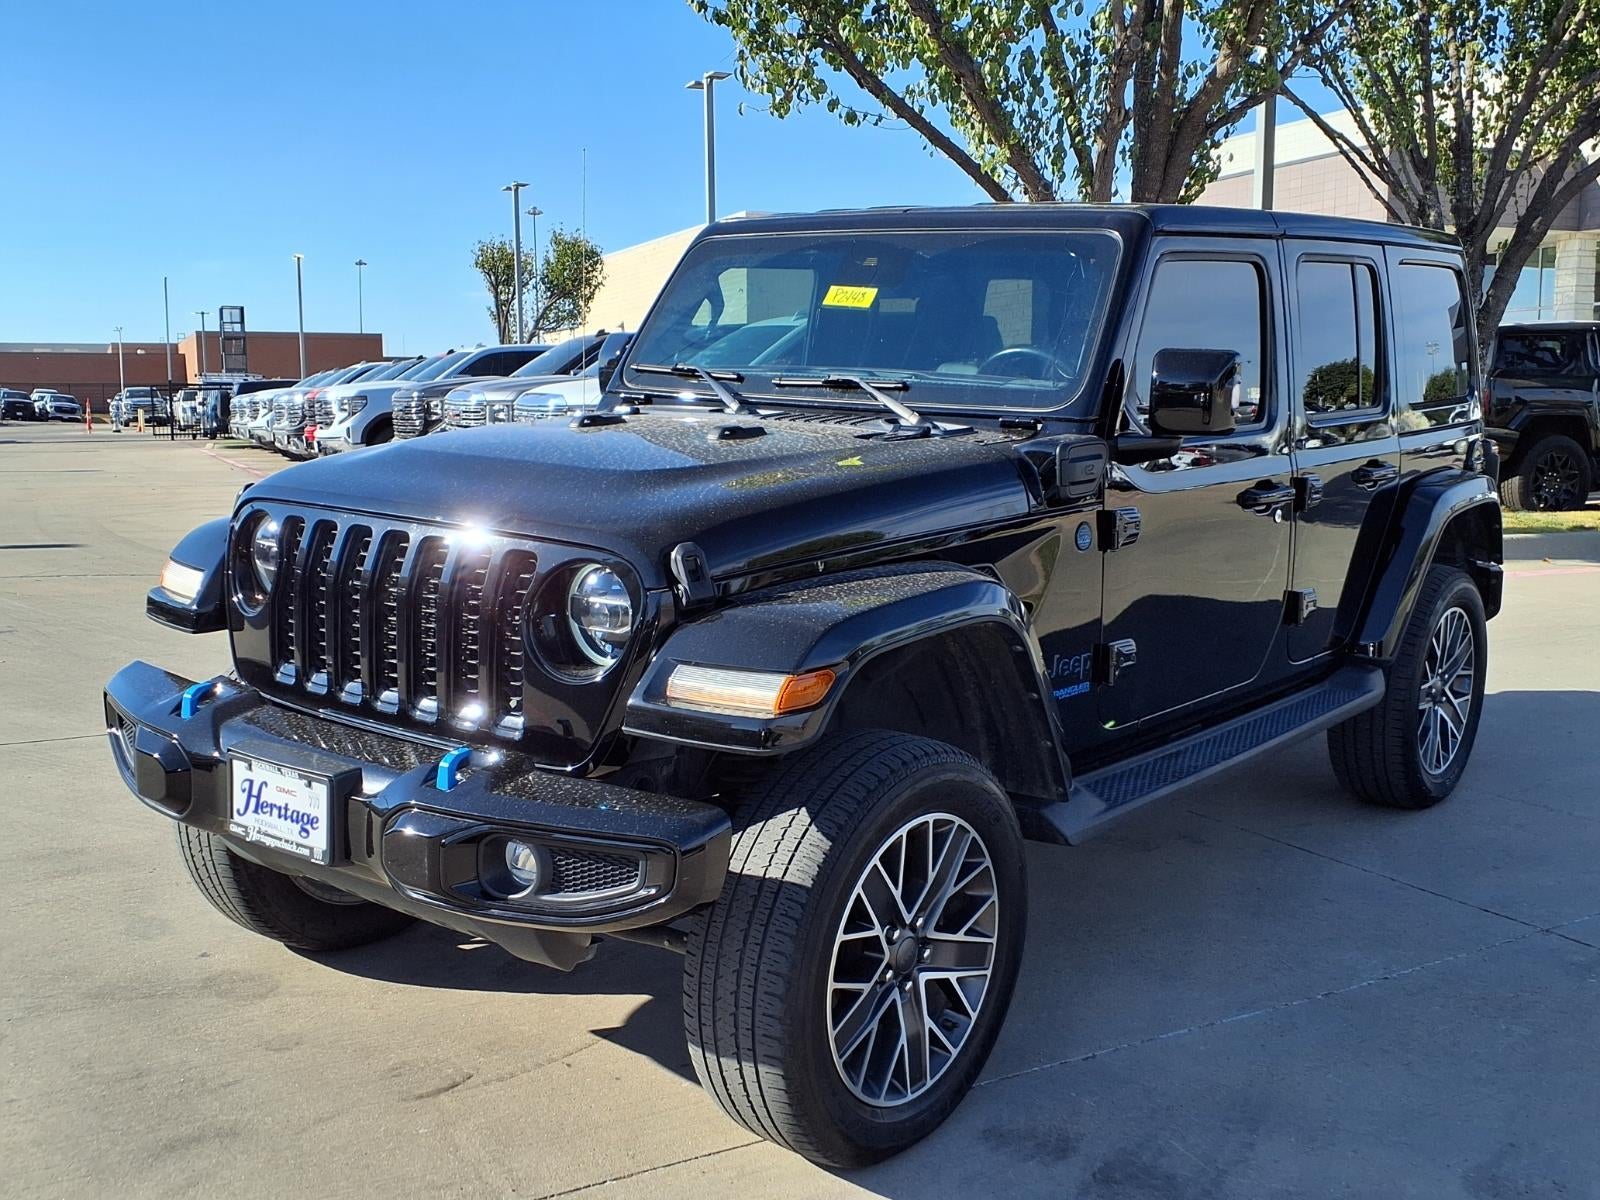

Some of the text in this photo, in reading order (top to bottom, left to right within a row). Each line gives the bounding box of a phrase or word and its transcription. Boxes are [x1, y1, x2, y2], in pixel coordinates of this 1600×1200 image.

[1048, 653, 1092, 680] Jeep
[276, 786, 297, 797] GMC
[236, 778, 319, 839] Heritage
